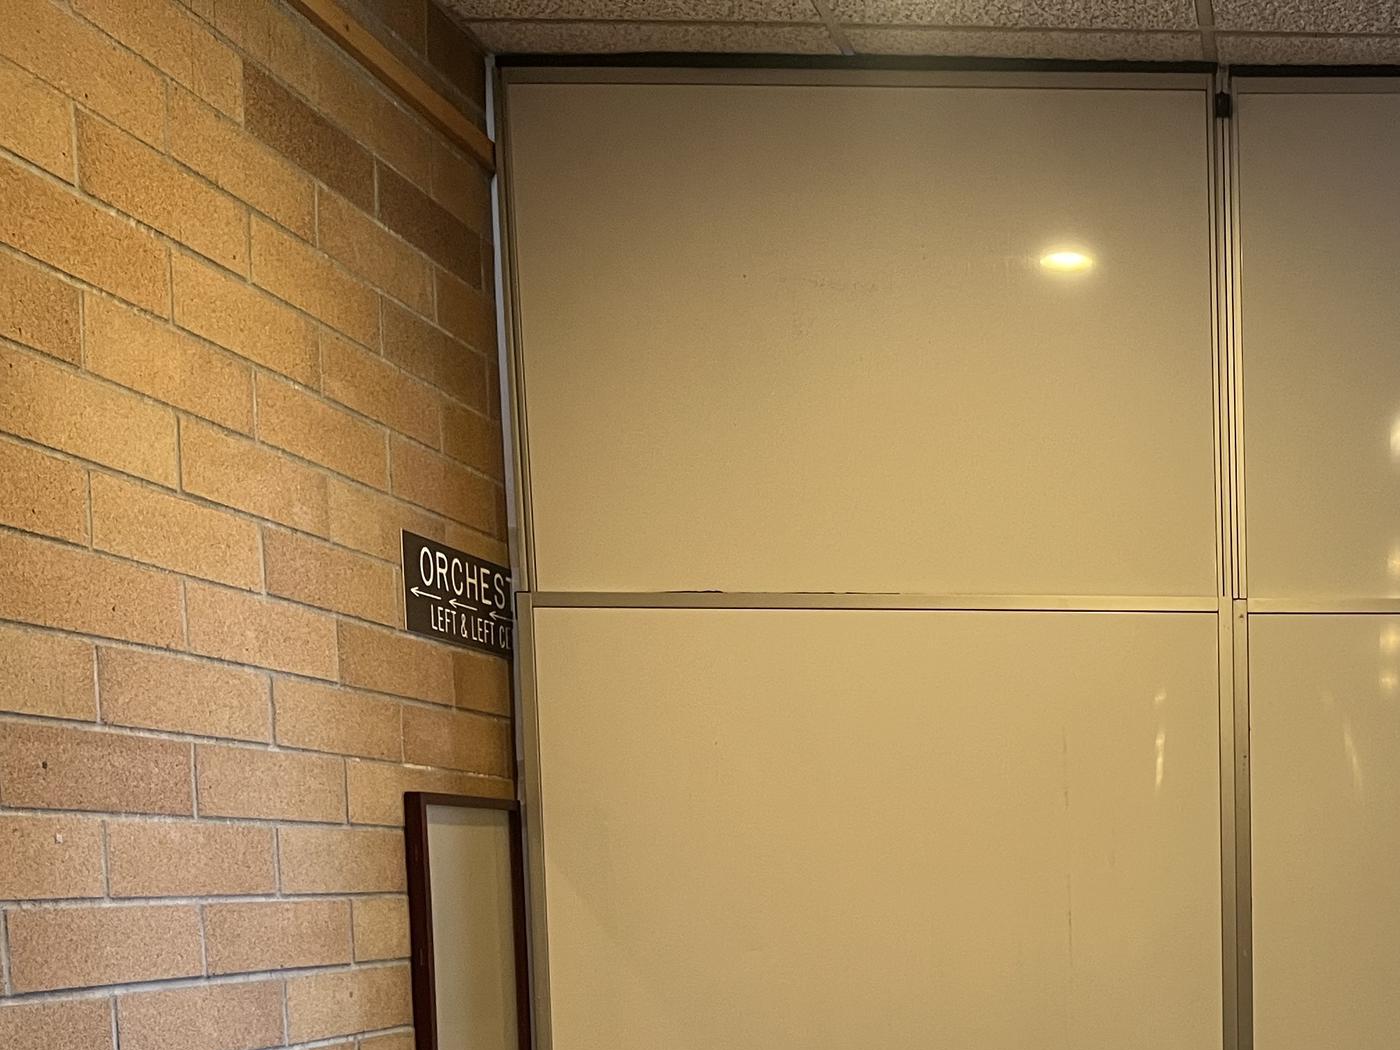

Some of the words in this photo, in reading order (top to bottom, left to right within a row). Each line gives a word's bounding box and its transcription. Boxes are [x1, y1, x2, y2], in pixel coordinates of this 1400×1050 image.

[419, 546, 512, 610] ORCHES
[430, 603, 457, 635] LEFT
[460, 613, 468, 639] &
[471, 615, 495, 646] LEFT
